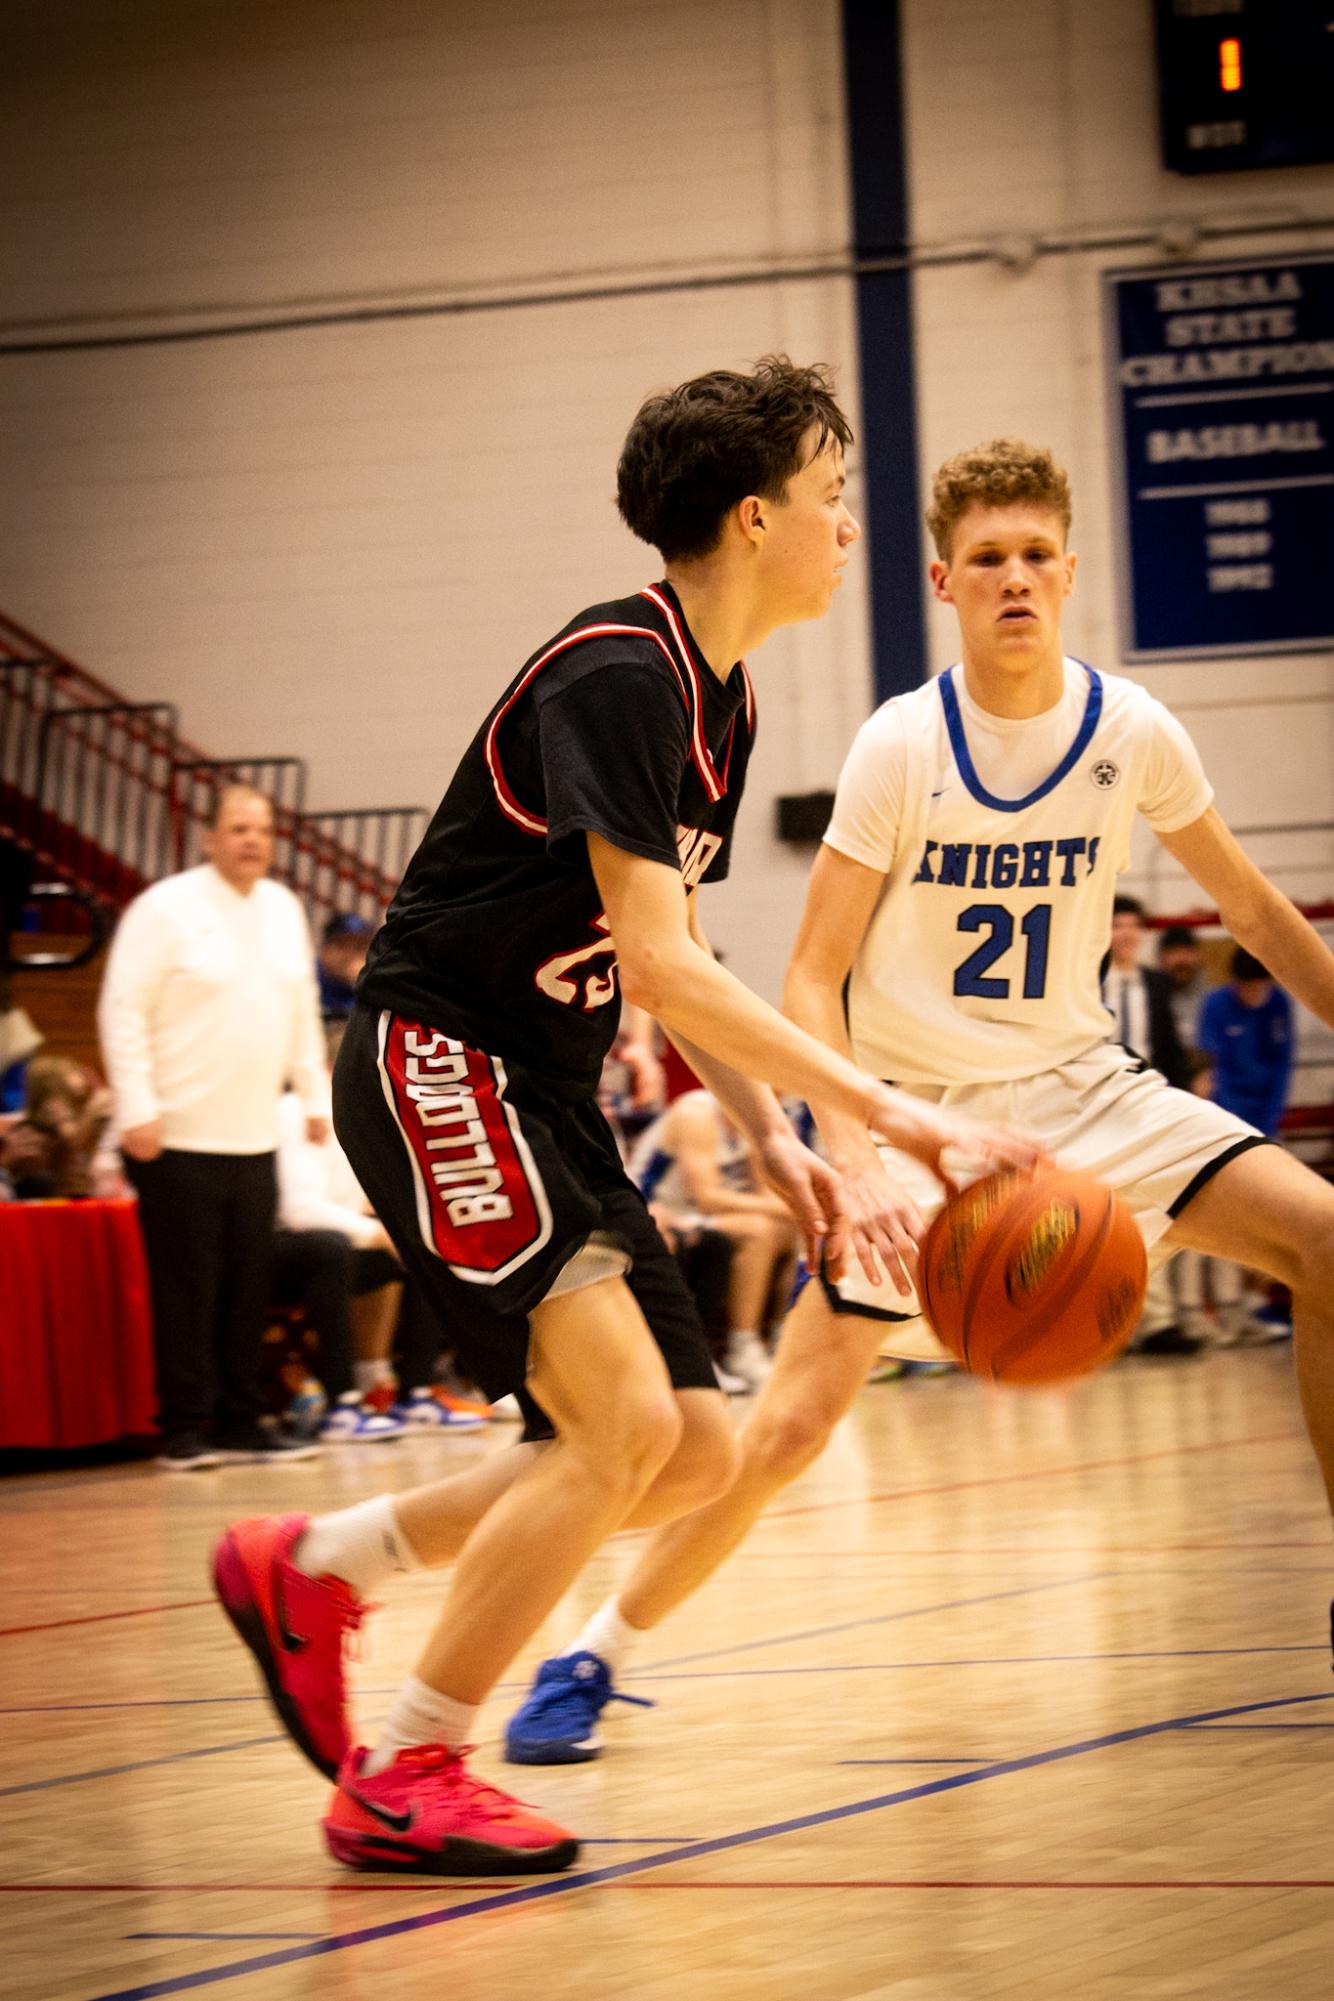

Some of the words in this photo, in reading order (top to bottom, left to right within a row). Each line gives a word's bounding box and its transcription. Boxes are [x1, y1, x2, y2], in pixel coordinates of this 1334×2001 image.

[1156, 272, 1301, 312] KHSAA
[1166, 306, 1297, 347] STATE
[1147, 419, 1322, 464] BASEBALL
[953, 904, 1052, 999] 21
[404, 1030, 514, 1227] BULLDOGS
